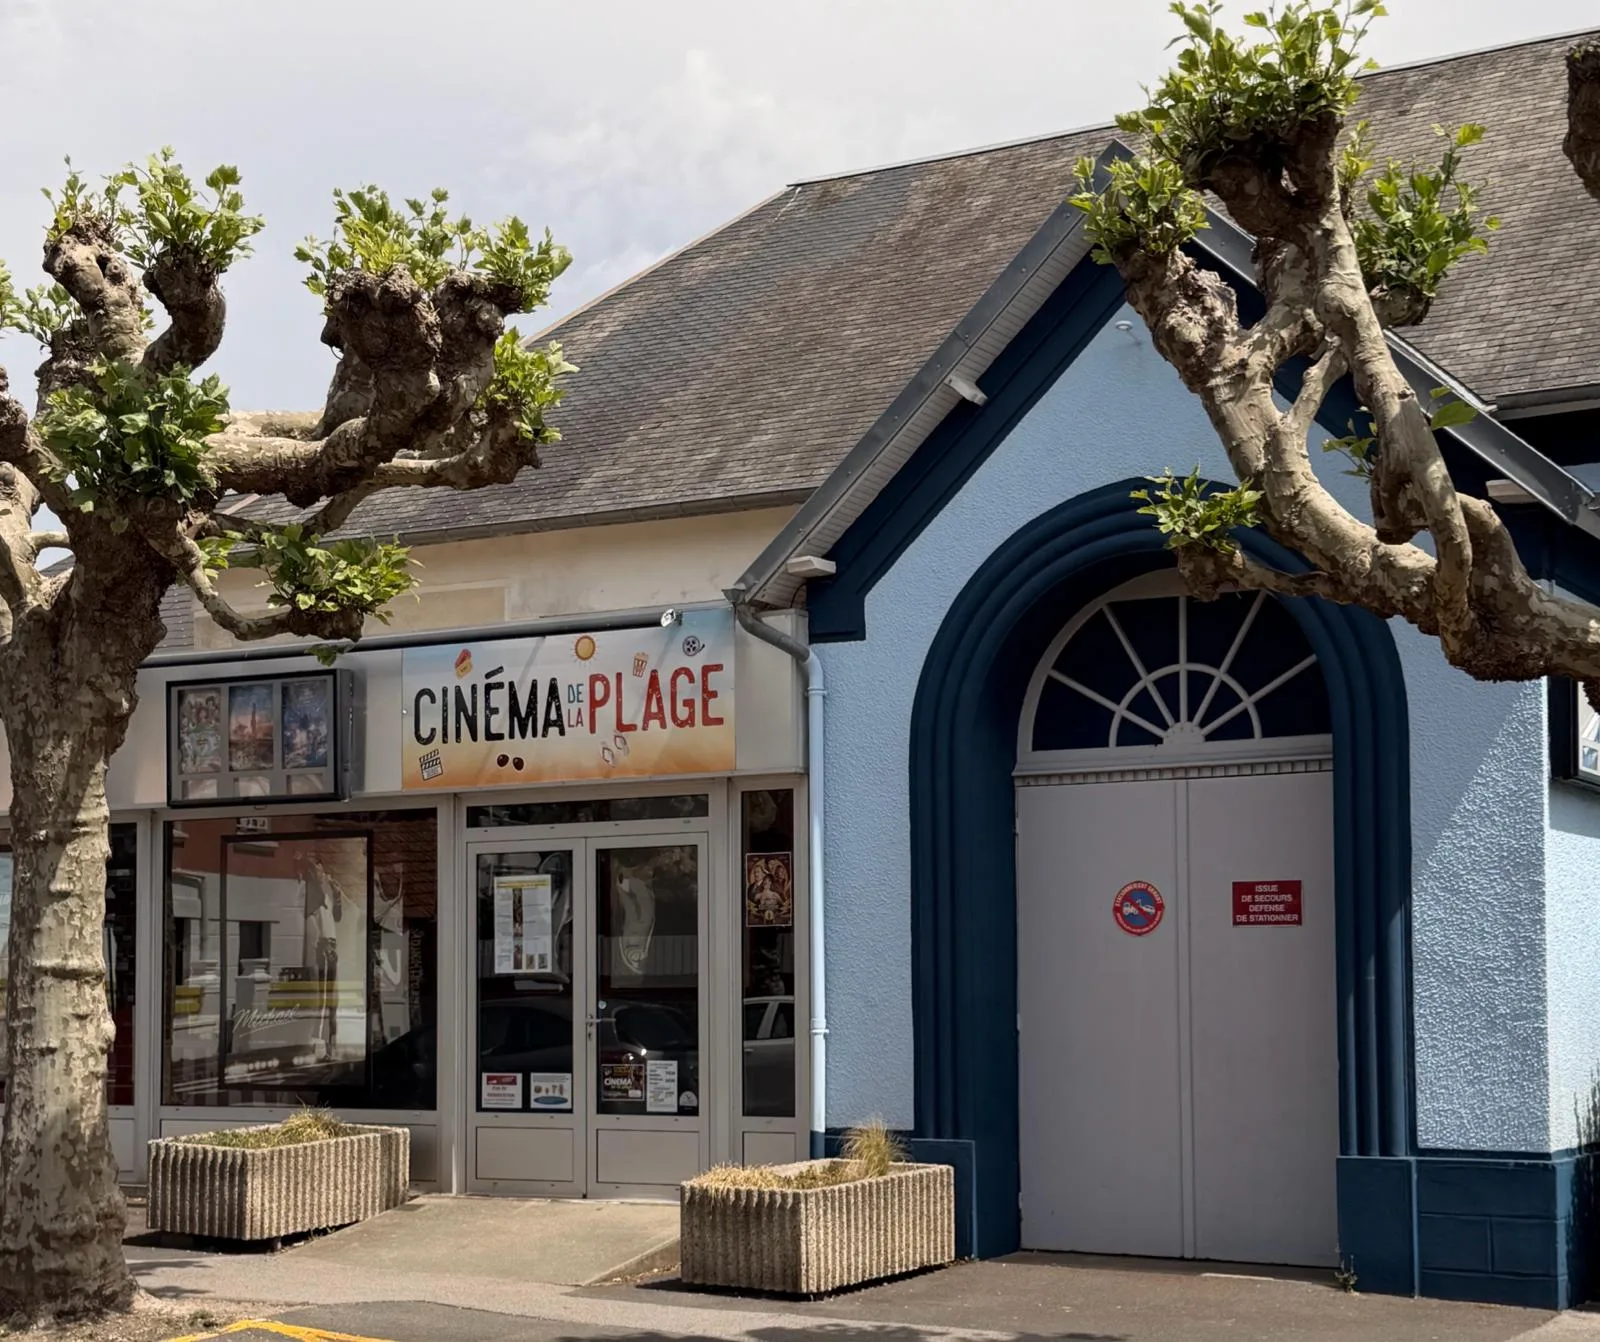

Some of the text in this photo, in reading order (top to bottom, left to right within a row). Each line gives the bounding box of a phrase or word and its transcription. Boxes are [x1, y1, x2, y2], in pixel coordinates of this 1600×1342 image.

[567, 682, 584, 704] DE
[588, 663, 725, 734] PLAGE
[414, 666, 566, 746] CINÉMA
[567, 707, 584, 729] LA
[1249, 904, 1286, 912] DEFENSE
[1254, 894, 1293, 902] SECOURS
[1249, 914, 1299, 922] STATIONNER
